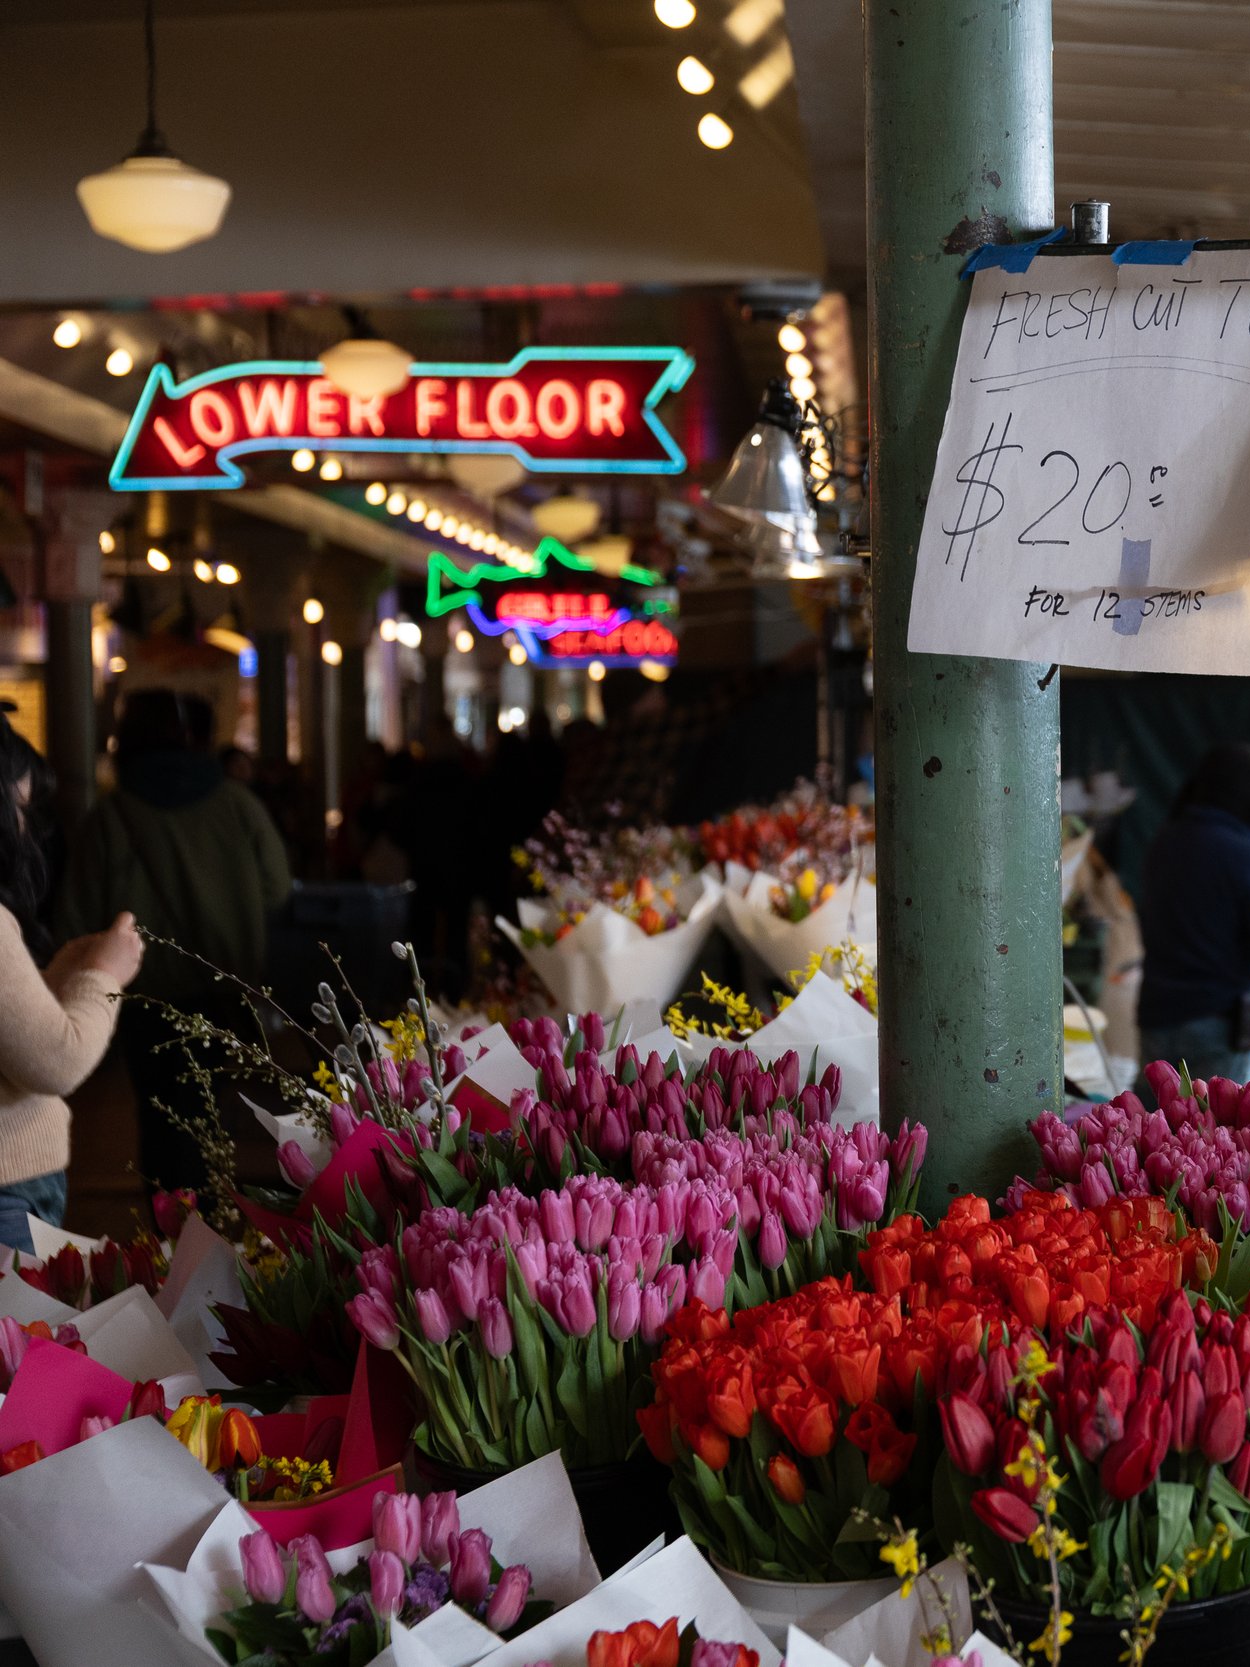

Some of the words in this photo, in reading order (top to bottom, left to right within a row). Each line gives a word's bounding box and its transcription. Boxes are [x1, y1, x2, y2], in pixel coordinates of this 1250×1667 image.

[984, 286, 1117, 359] FRESH
[152, 378, 386, 468] LOWER
[416, 378, 626, 440] FLOOR
[1024, 584, 1070, 618] FOR
[1093, 589, 1122, 621] 12
[1140, 590, 1206, 617] STEMS
